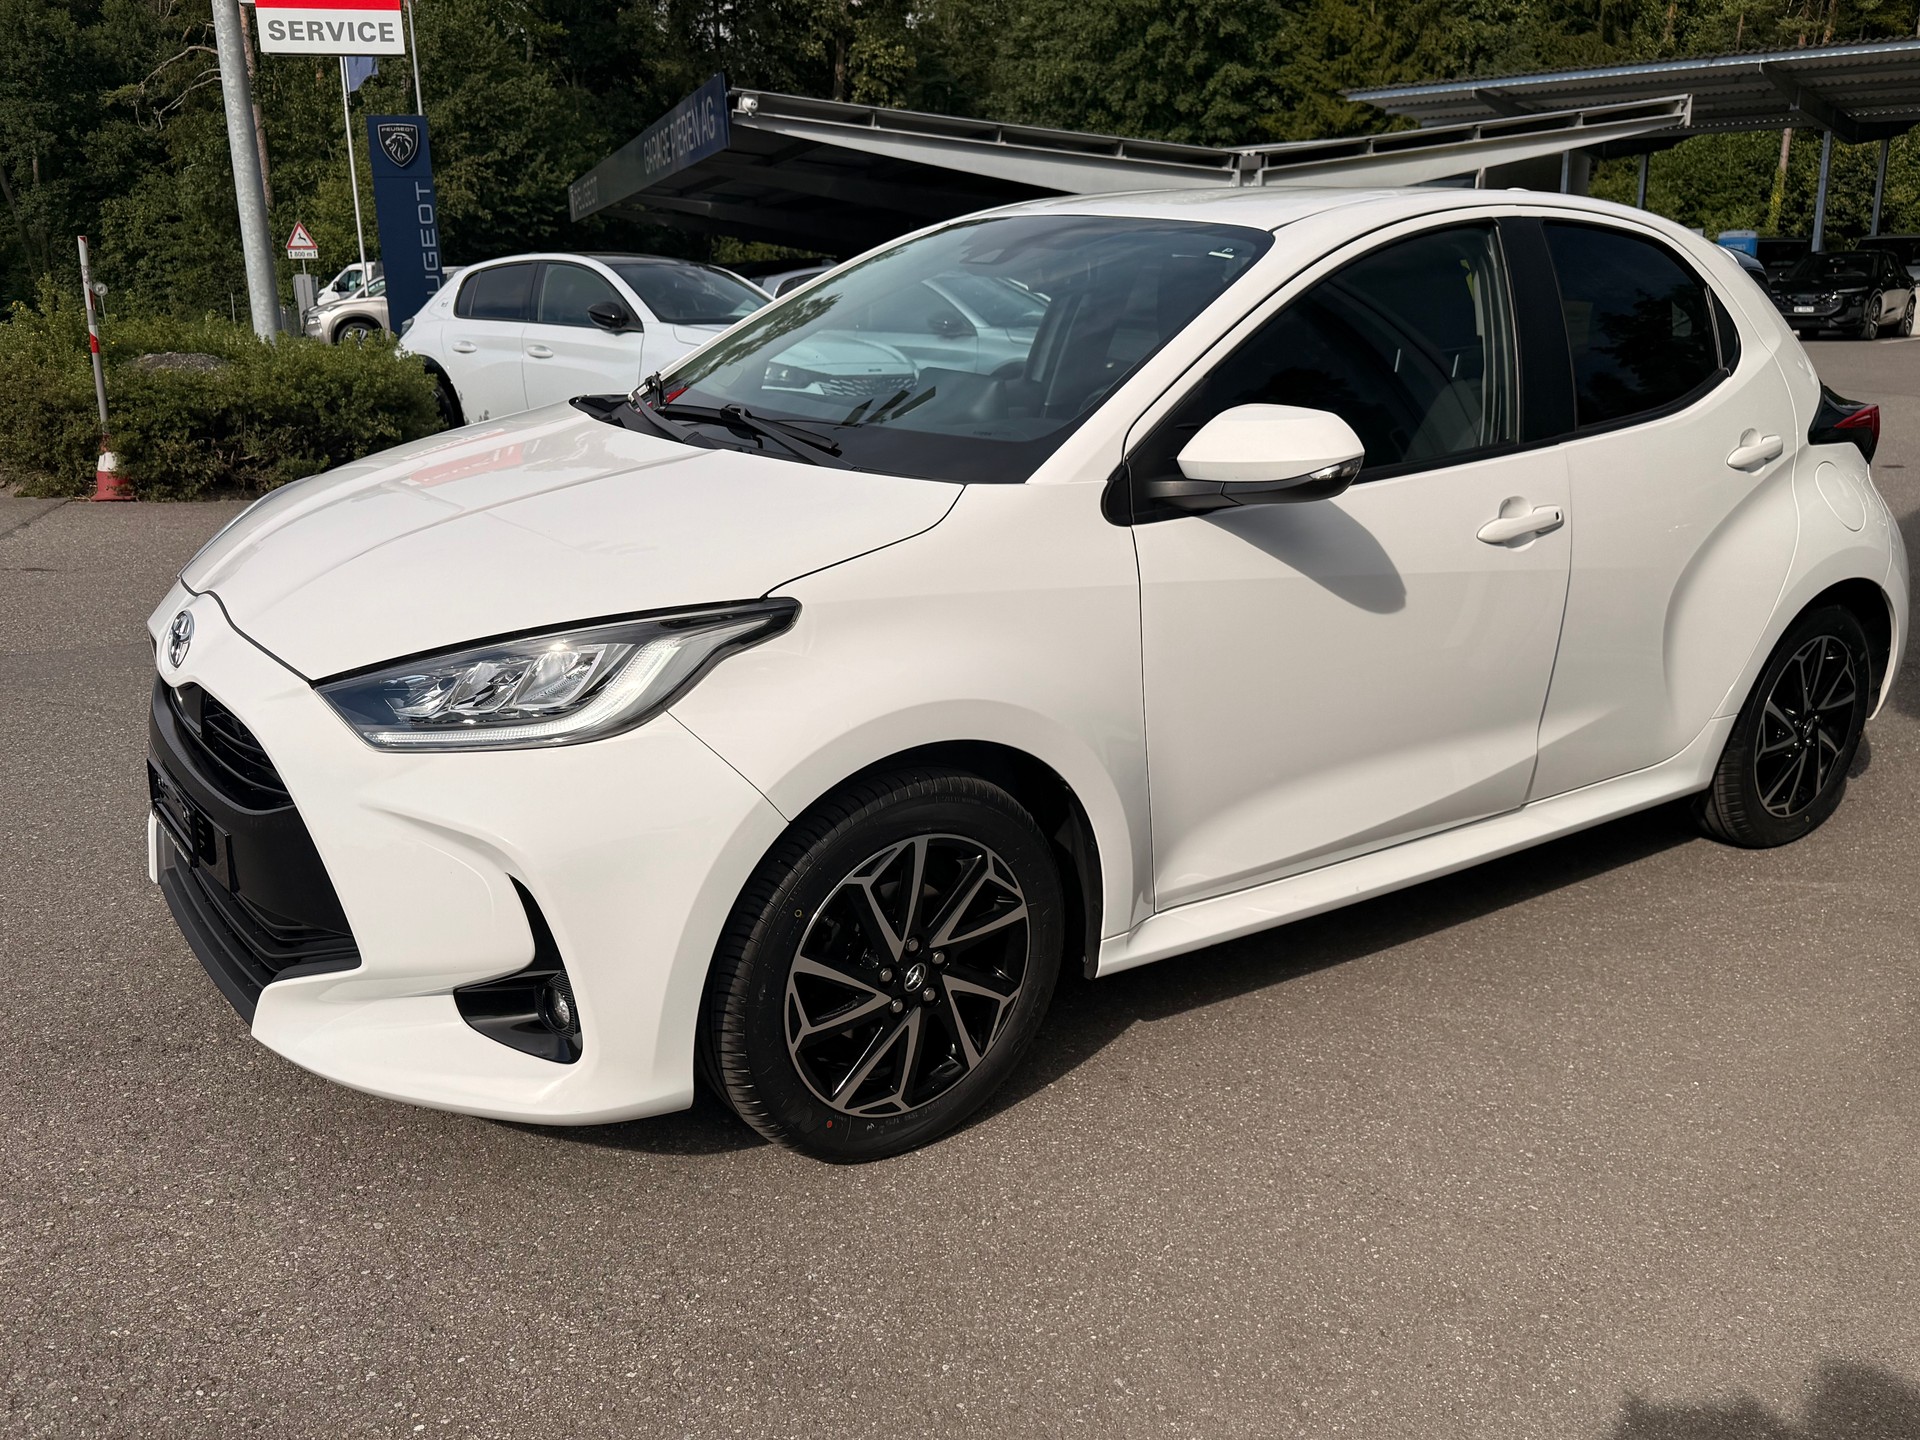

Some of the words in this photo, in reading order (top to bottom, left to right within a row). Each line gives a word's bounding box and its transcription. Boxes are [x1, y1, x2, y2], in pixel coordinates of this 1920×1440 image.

[267, 20, 395, 42] SERVICE
[670, 106, 701, 161] PIEREN
[701, 95, 716, 145] AG
[415, 181, 440, 295] UGEOT
